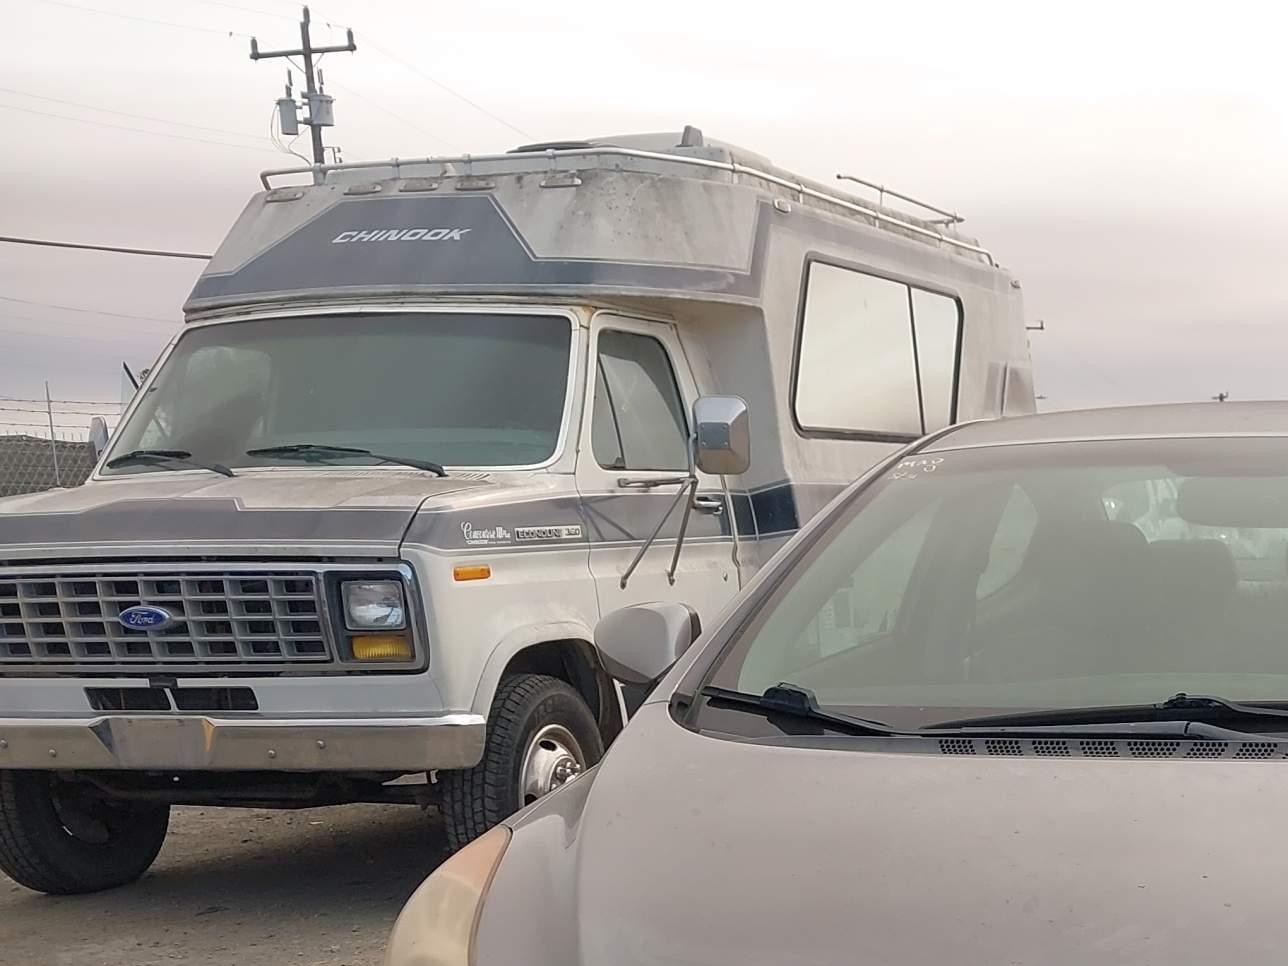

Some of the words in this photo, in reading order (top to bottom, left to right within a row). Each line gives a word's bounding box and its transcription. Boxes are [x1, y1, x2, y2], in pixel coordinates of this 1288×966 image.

[332, 228, 472, 243] CHINOOK
[516, 527, 563, 539] ECONOLIN
[129, 611, 155, 624] Ford
